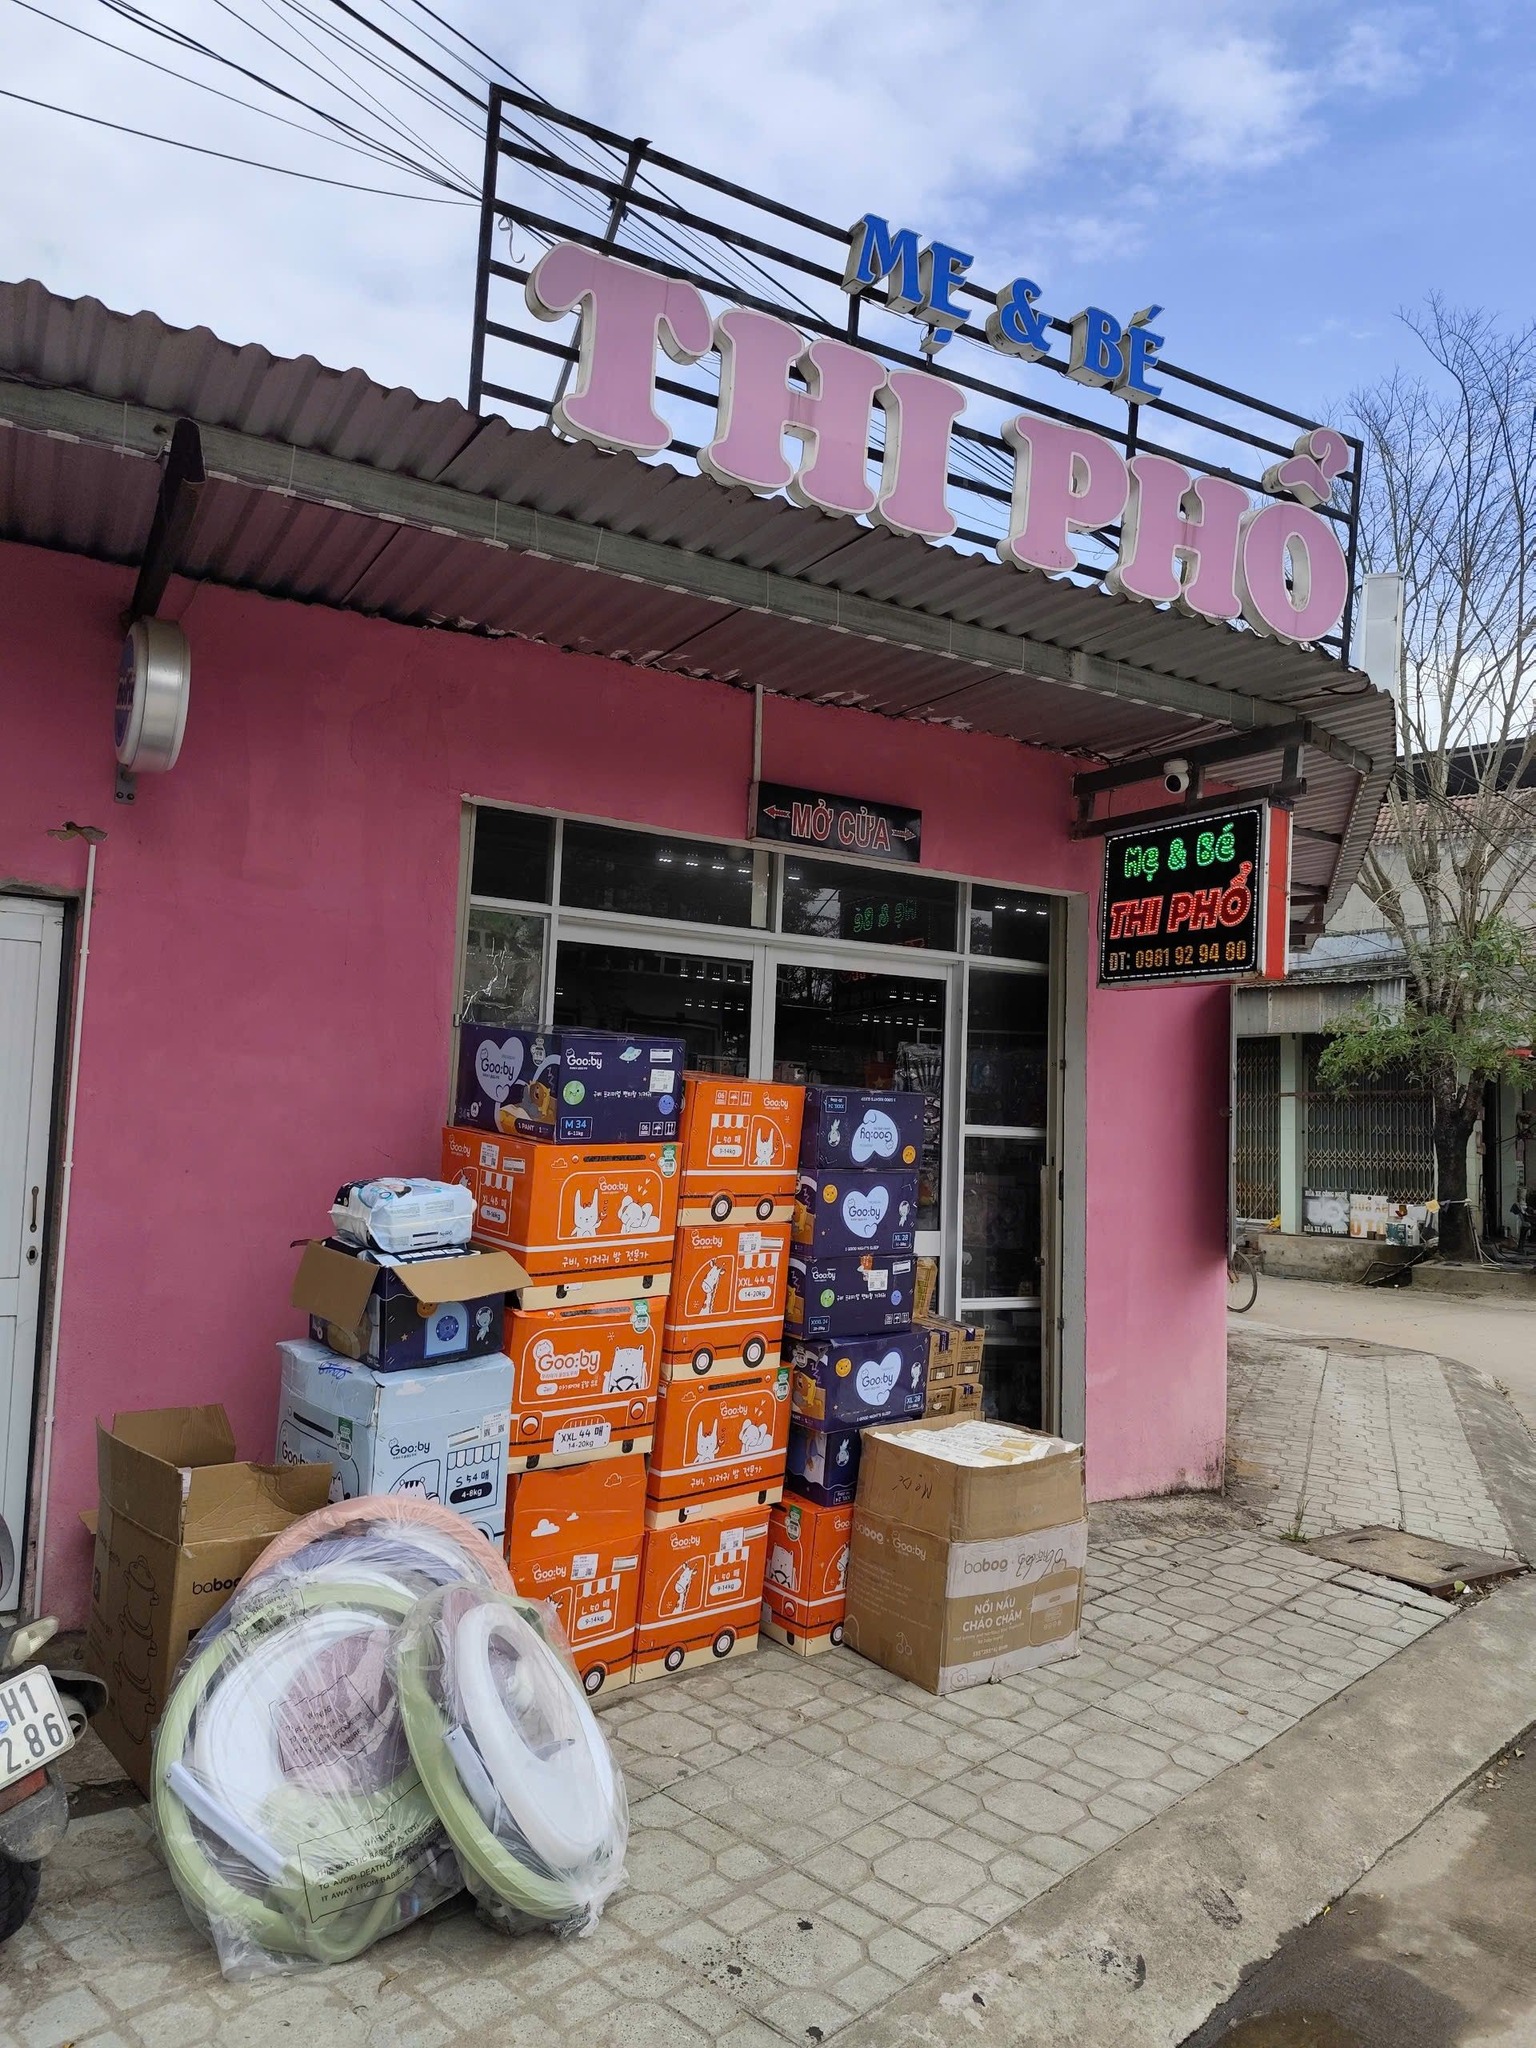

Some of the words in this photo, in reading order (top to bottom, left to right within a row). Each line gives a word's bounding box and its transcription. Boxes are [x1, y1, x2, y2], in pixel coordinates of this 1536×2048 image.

[858, 213, 974, 346] MẸ
[997, 277, 1054, 356] &
[1079, 305, 1165, 396] BÉ
[526, 241, 967, 537] THI
[790, 799, 834, 841] MỞ
[837, 799, 891, 852] CỬA
[1167, 837, 1187, 871] &
[1110, 895, 1164, 940] THI
[1135, 947, 1170, 968] 0981
[1175, 945, 1194, 966] 92
[1199, 943, 1220, 964] 94
[481, 1057, 515, 1081] Goo:by
[566, 1055, 603, 1070] Goo:by
[763, 1097, 789, 1110] Goo:by
[565, 1120, 574, 1129] M
[575, 1119, 587, 1129] 34
[859, 1127, 893, 1143] Goo:by
[600, 1181, 629, 1193] Goo:by
[848, 1205, 881, 1221] Goo:by
[692, 1236, 723, 1248] Goo:by
[539, 1351, 598, 1373] Goo:by
[861, 1372, 894, 1388] Goo:by
[721, 1405, 748, 1417] Goo:by
[561, 1432, 577, 1443] XXL
[579, 1429, 591, 1438] 44
[390, 1441, 431, 1457] Goo:by
[568, 1440, 595, 1450] 14-20kg
[455, 1476, 463, 1487] S
[461, 1487, 483, 1499] 4-8kg
[671, 1535, 701, 1548] Goo:by
[892, 1538, 927, 1561] Goo:by
[533, 1565, 567, 1580] Goo:by
[963, 1558, 1008, 1575] baboo
[714, 1574, 719, 1582] L
[582, 1606, 587, 1615] L
[962, 1617, 993, 1633] CHÁO
[318, 1880, 330, 1891] TO
[333, 1872, 357, 1887] AVOID
[360, 1862, 386, 1879] DEATH
[321, 1892, 330, 1903] IT
[331, 1887, 354, 1900] AWAY
[355, 1878, 380, 1892] FROM
[380, 1865, 406, 1885] BABIES
